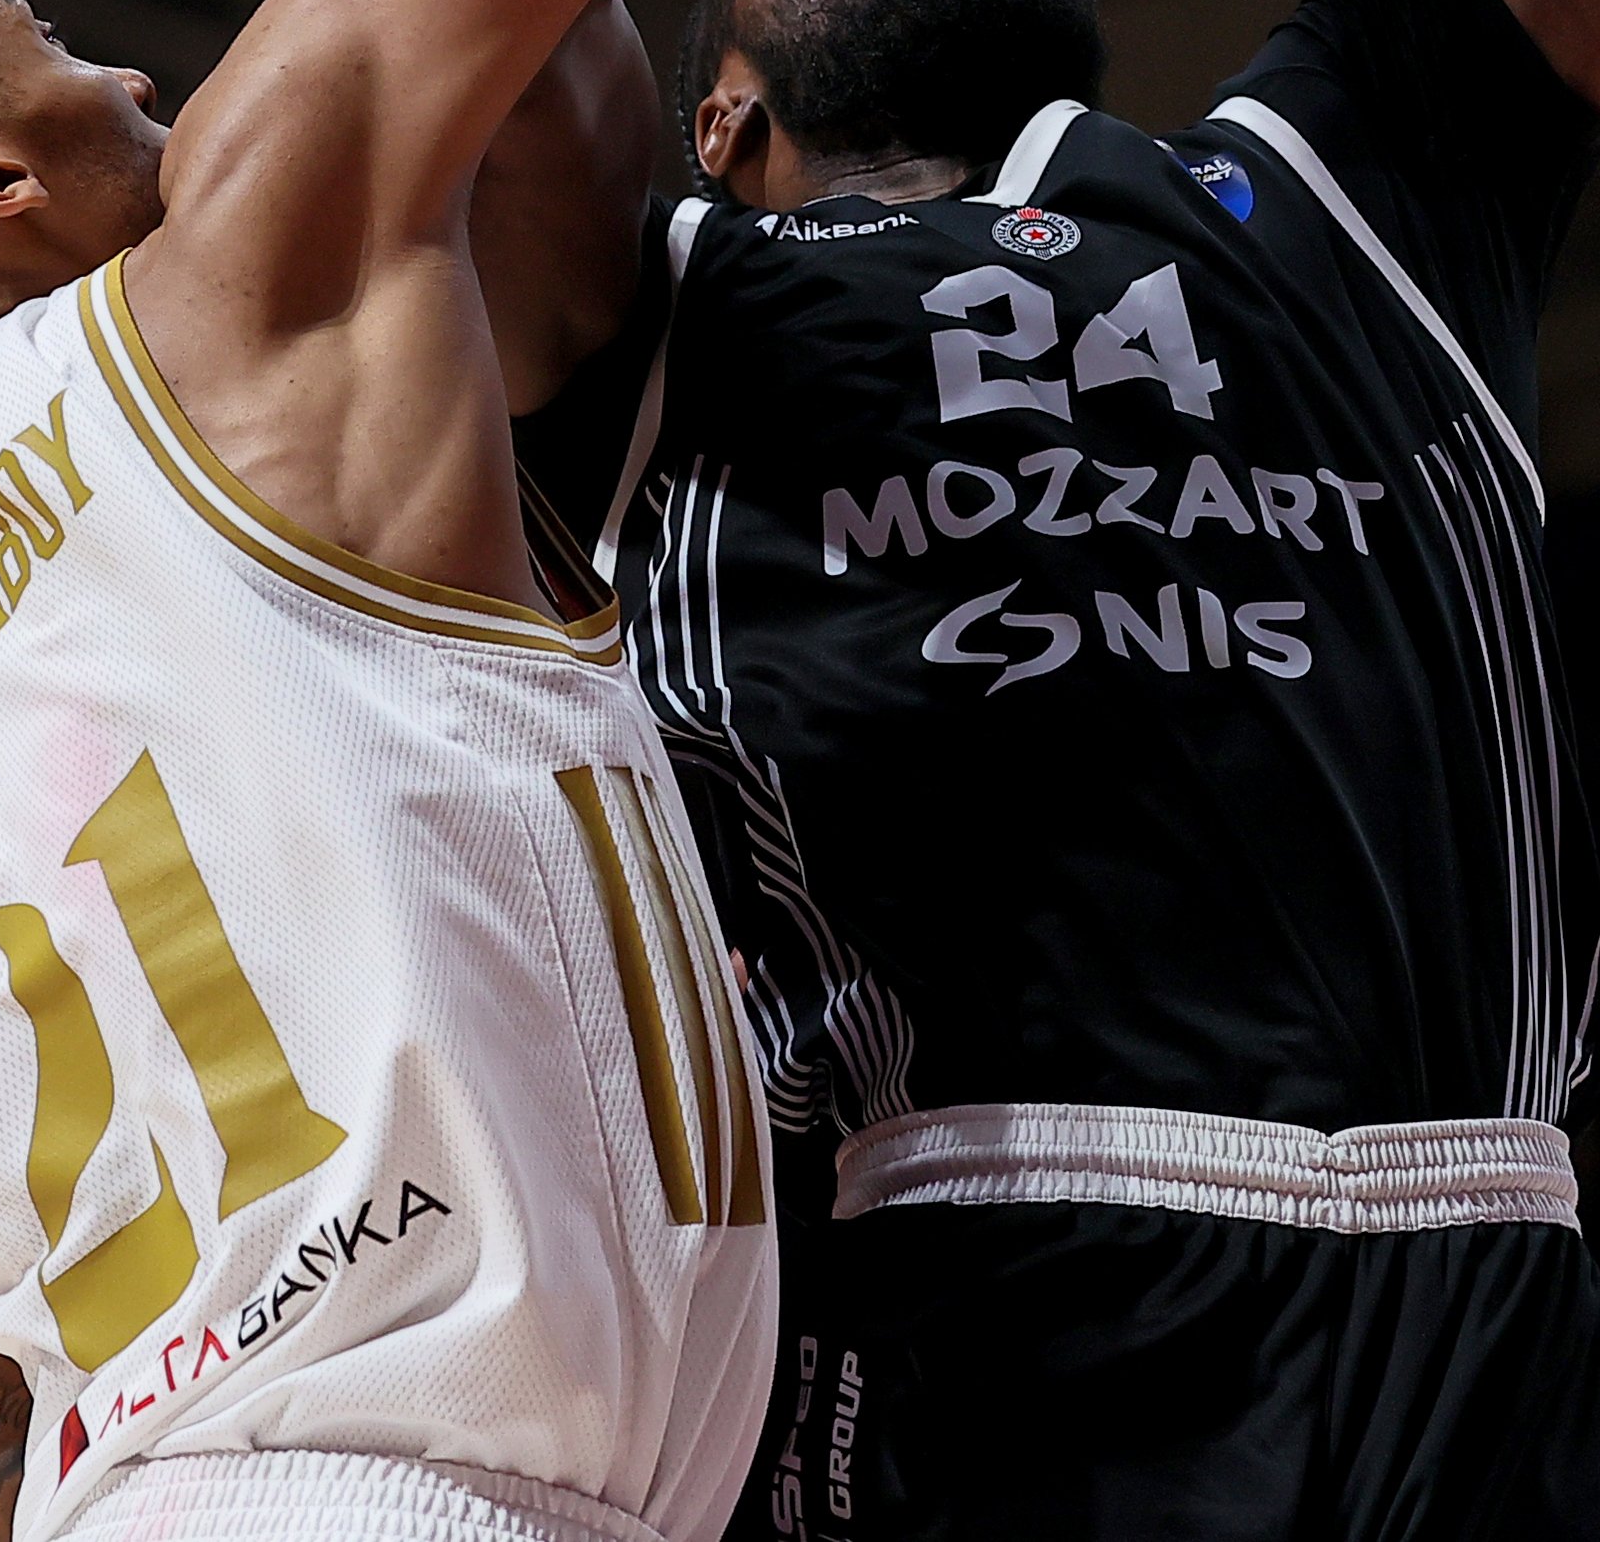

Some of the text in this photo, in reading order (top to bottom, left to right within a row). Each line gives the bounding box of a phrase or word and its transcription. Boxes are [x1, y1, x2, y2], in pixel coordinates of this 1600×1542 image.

[776, 213, 920, 241] AikBank
[920, 262, 1223, 423] 24
[823, 447, 1384, 577] MOZZART
[1095, 582, 1312, 679] NIS
[828, 1350, 863, 1520] GROUP
